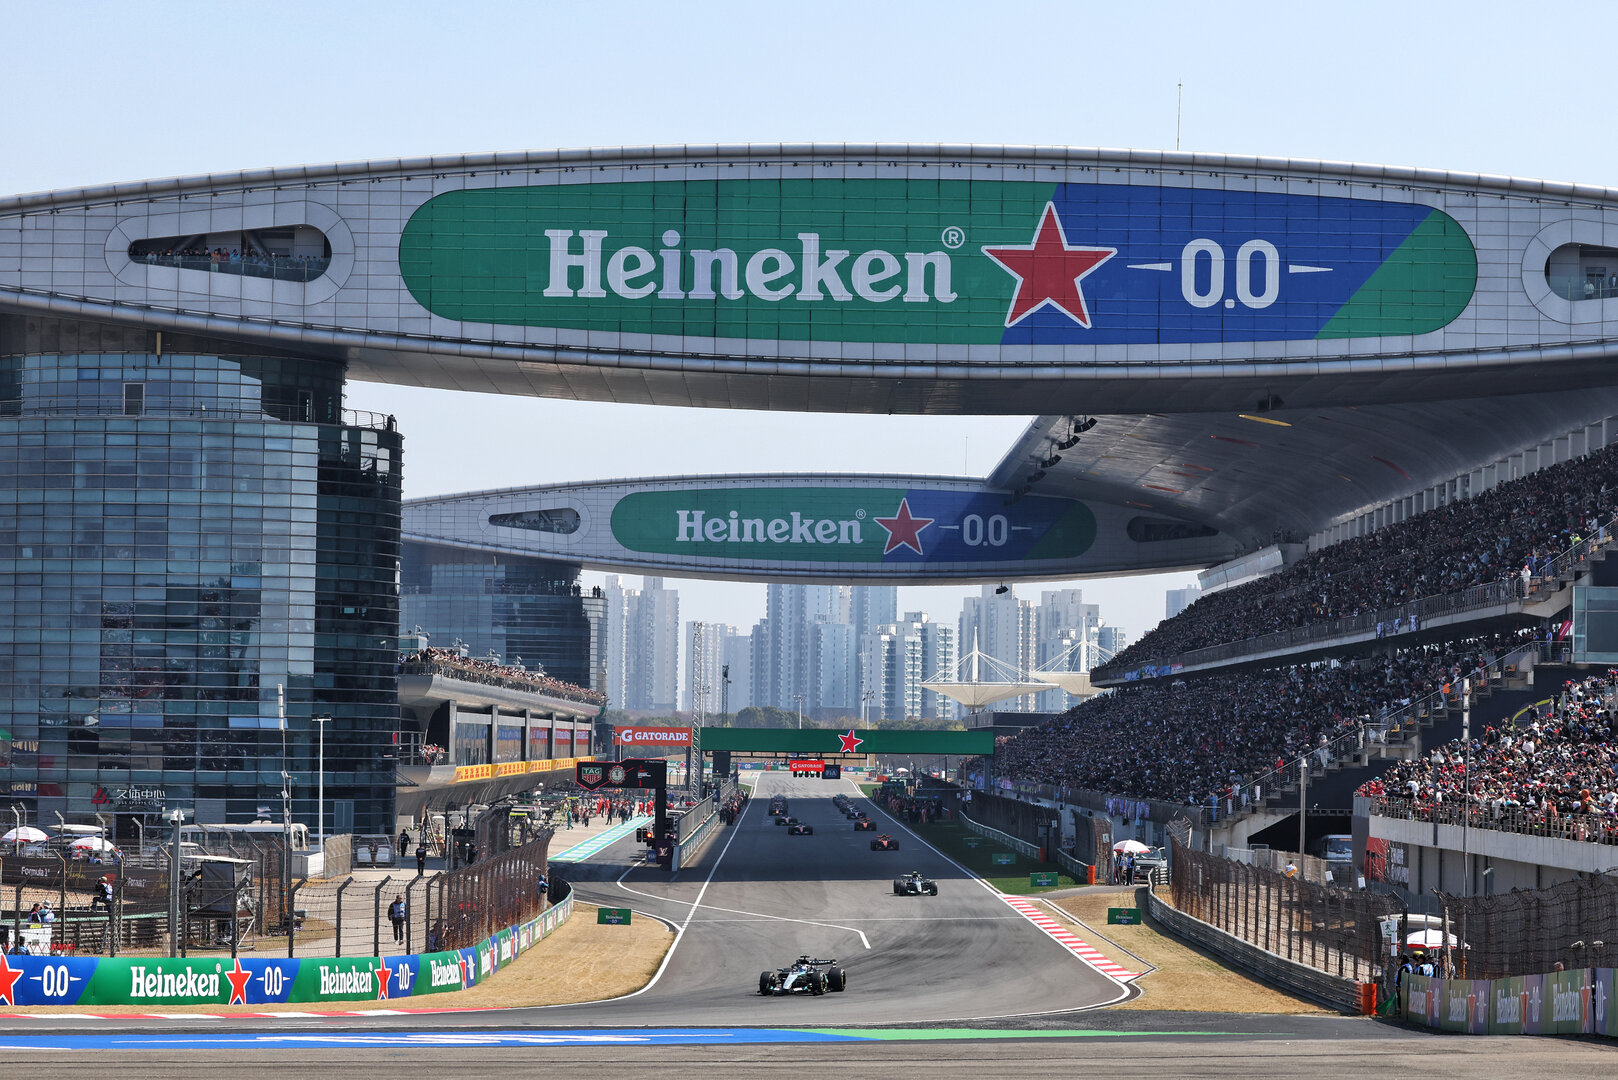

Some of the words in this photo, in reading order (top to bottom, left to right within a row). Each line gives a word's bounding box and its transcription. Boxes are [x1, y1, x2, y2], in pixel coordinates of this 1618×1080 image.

[1181, 238, 1280, 310] 0.0
[963, 514, 1008, 546] 0.0
[634, 731, 689, 741] GATORADE
[21, 866, 43, 877] Formula
[43, 965, 69, 997] 0.0
[264, 966, 283, 996] 0.0
[398, 963, 410, 991] 0.0
